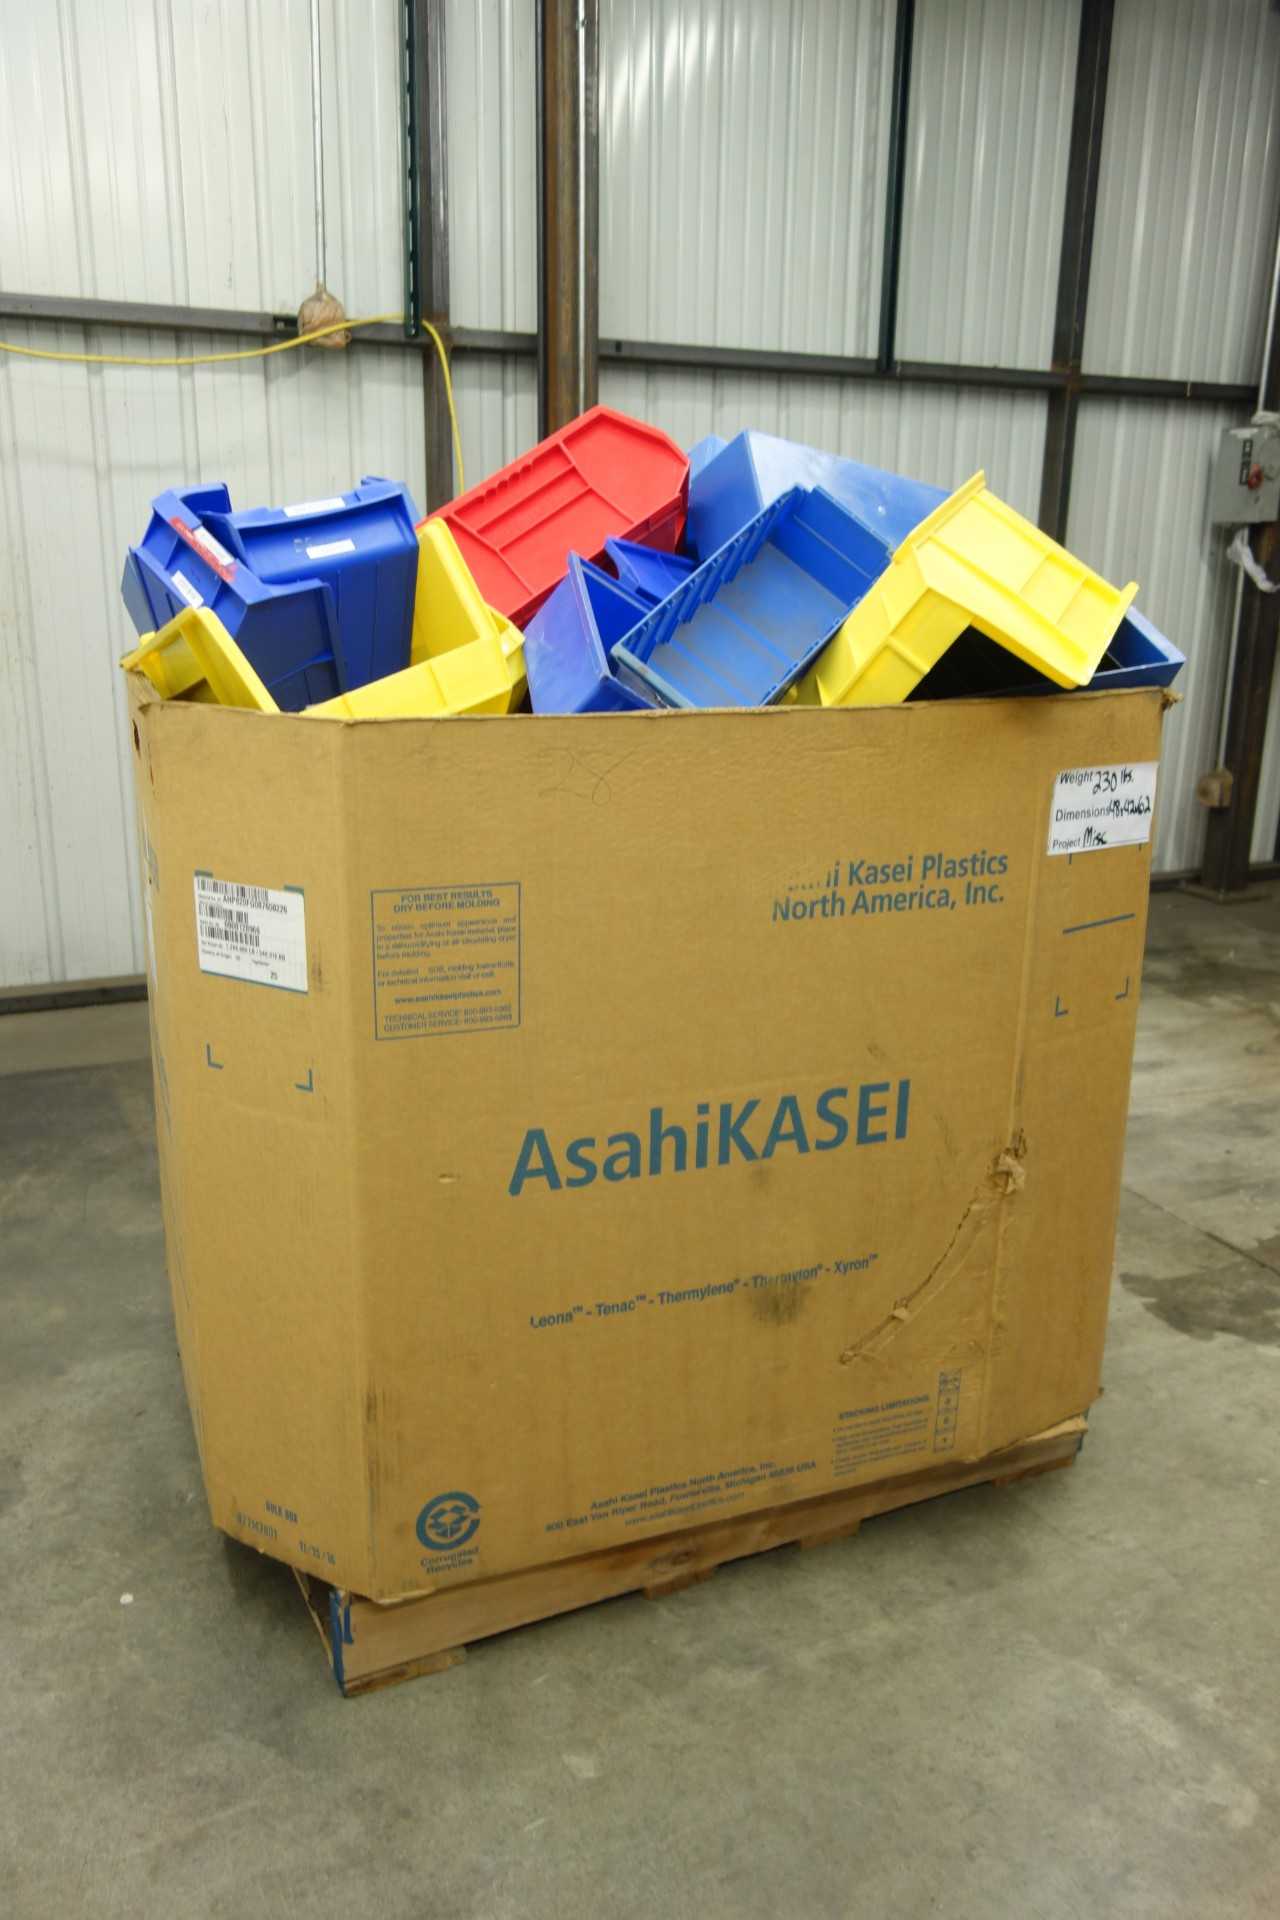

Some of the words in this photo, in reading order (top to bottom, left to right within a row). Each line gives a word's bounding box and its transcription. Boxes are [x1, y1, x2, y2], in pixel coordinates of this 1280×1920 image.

[1092, 770, 1117, 795] 230
[848, 855, 913, 886] Kasei
[921, 850, 1008, 881] Plastics
[393, 904, 415, 914] DRY
[416, 901, 453, 912] BEFORE
[457, 898, 500, 910] MOLDING
[401, 893, 421, 904] FOR
[424, 891, 448, 902] BEST
[451, 888, 493, 900] RESULTS
[772, 890, 845, 922] North
[851, 884, 957, 916] America,
[965, 881, 1004, 905] Inc.
[508, 1079, 910, 1197] AsahiKASEI
